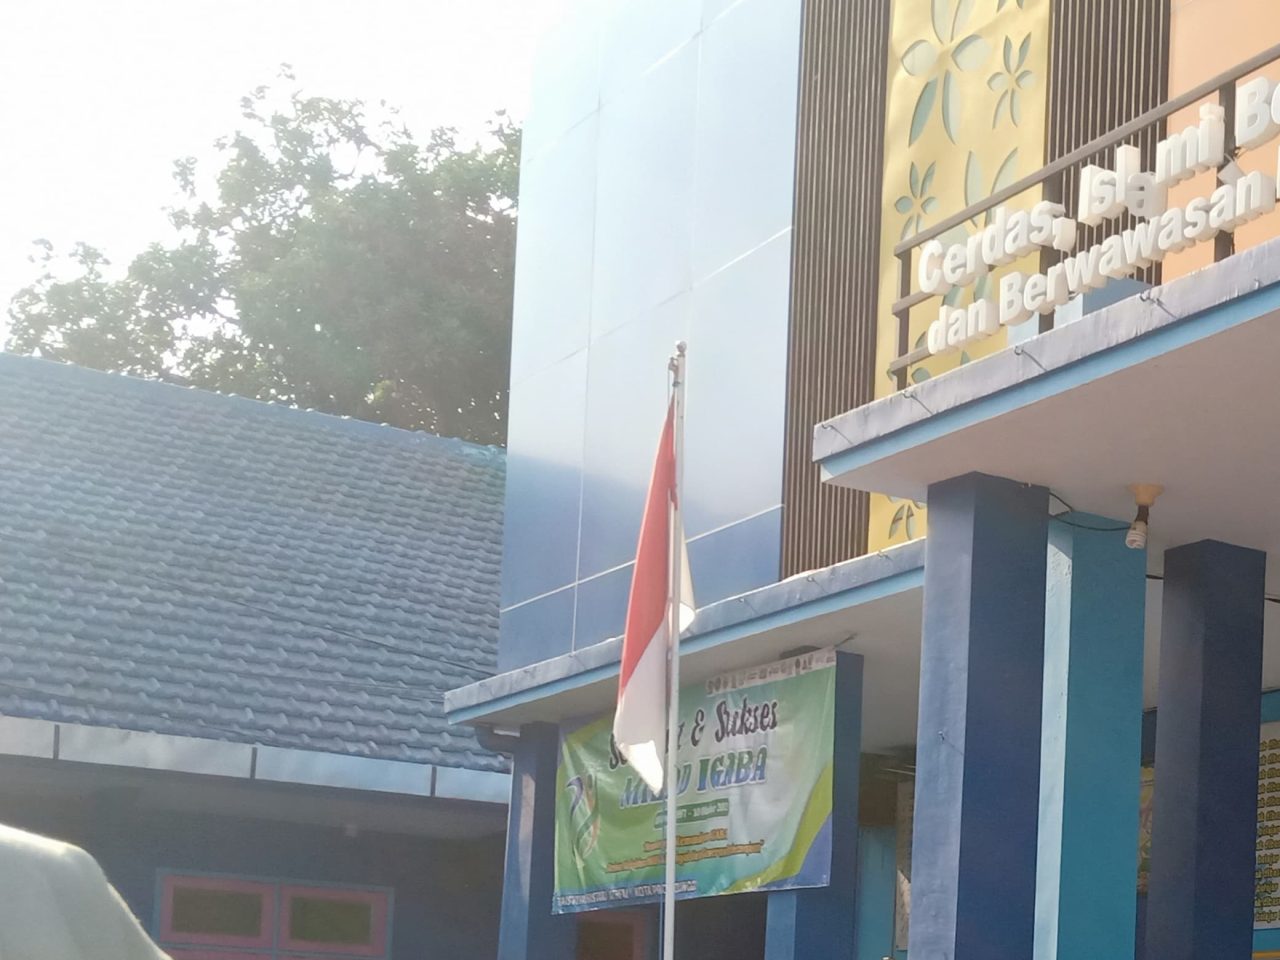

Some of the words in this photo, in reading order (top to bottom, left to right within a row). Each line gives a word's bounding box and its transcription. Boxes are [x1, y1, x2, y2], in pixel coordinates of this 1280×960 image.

[919, 200, 1077, 295] Cerdas,
[1078, 102, 1226, 227] Islami
[928, 298, 1000, 356] dan
[1000, 170, 1277, 327] Berwawasan
[690, 708, 705, 747] &
[714, 696, 779, 744] Sukses
[697, 746, 768, 793] IGABA
